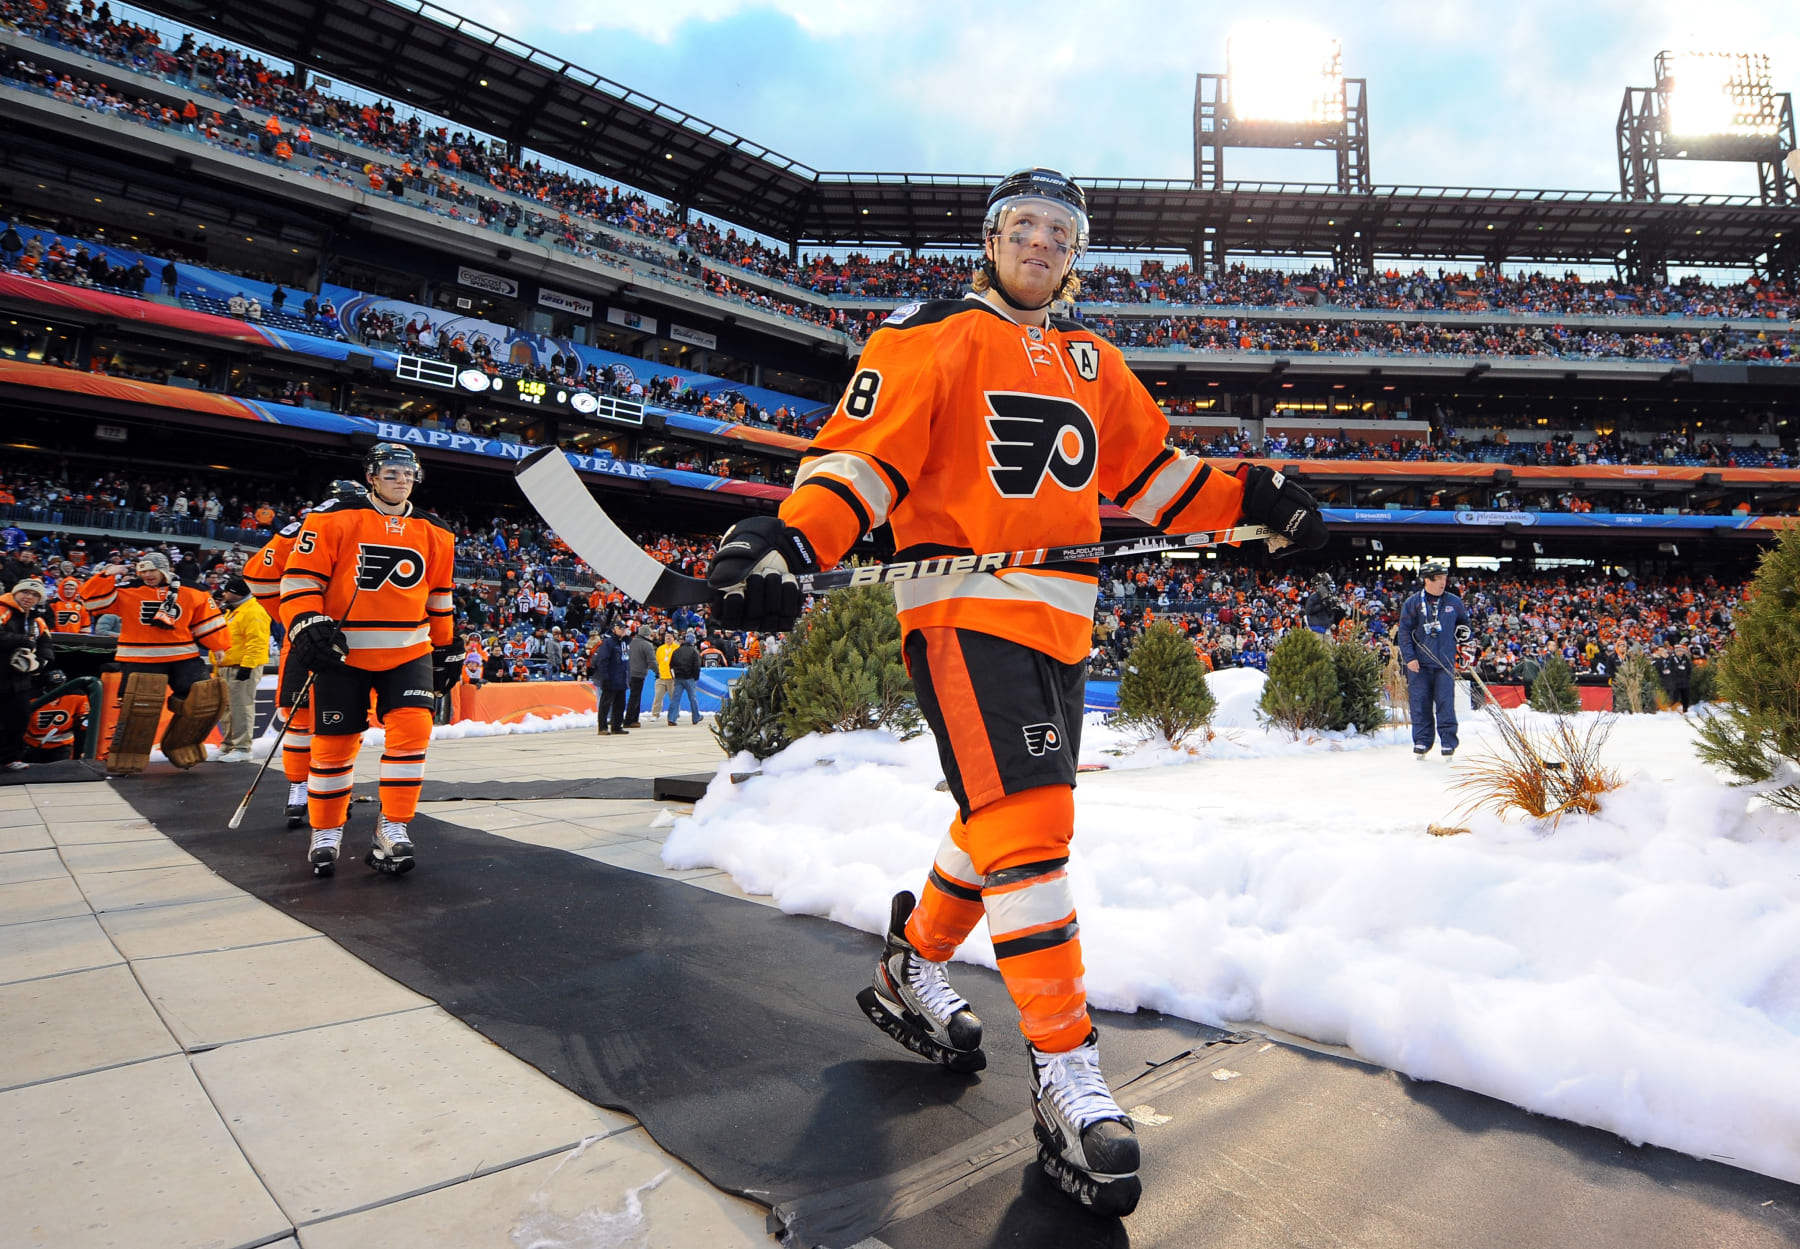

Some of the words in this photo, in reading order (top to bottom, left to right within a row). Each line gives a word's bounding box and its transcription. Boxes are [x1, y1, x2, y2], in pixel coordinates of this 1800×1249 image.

[541, 294, 564, 304] 1210
[1081, 349, 1094, 375] A
[832, 368, 883, 422] 8
[376, 422, 491, 453] HAPPY
[573, 453, 648, 479] YEAR
[263, 548, 276, 567] 5
[403, 689, 435, 699] BAUE
